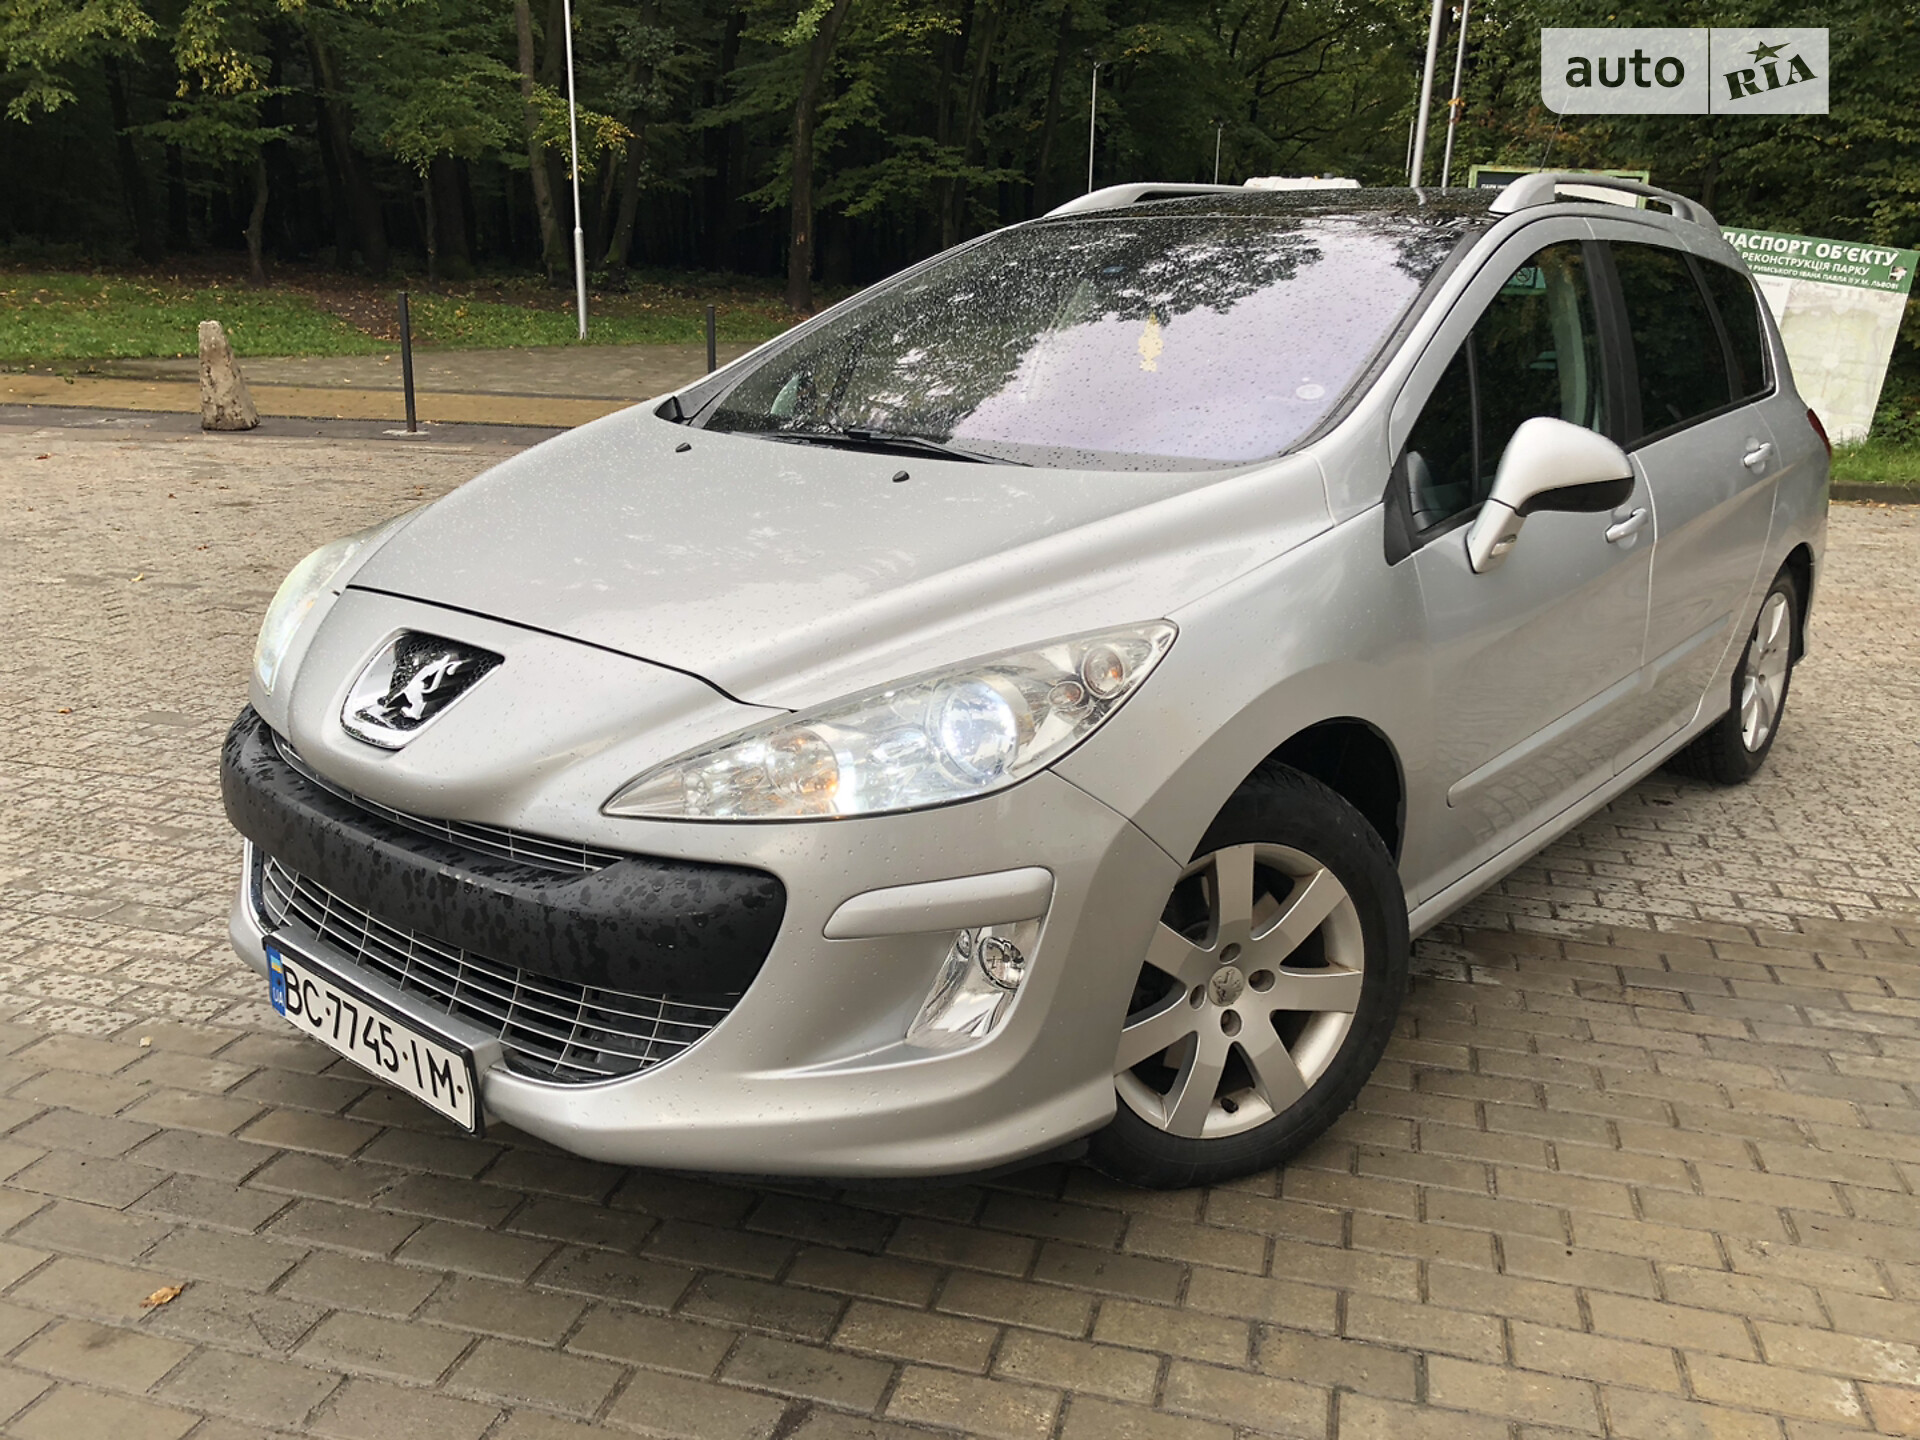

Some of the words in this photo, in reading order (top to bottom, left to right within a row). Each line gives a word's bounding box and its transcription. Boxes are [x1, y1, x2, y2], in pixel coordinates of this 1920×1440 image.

[1722, 231, 1813, 256] ПАСПОРТ
[1742, 252, 1829, 272] РЕКОНСТРУКЦІЯ
[1832, 263, 1870, 277] ПАРКУ
[272, 987, 284, 1004] UA
[326, 991, 399, 1073] 7745
